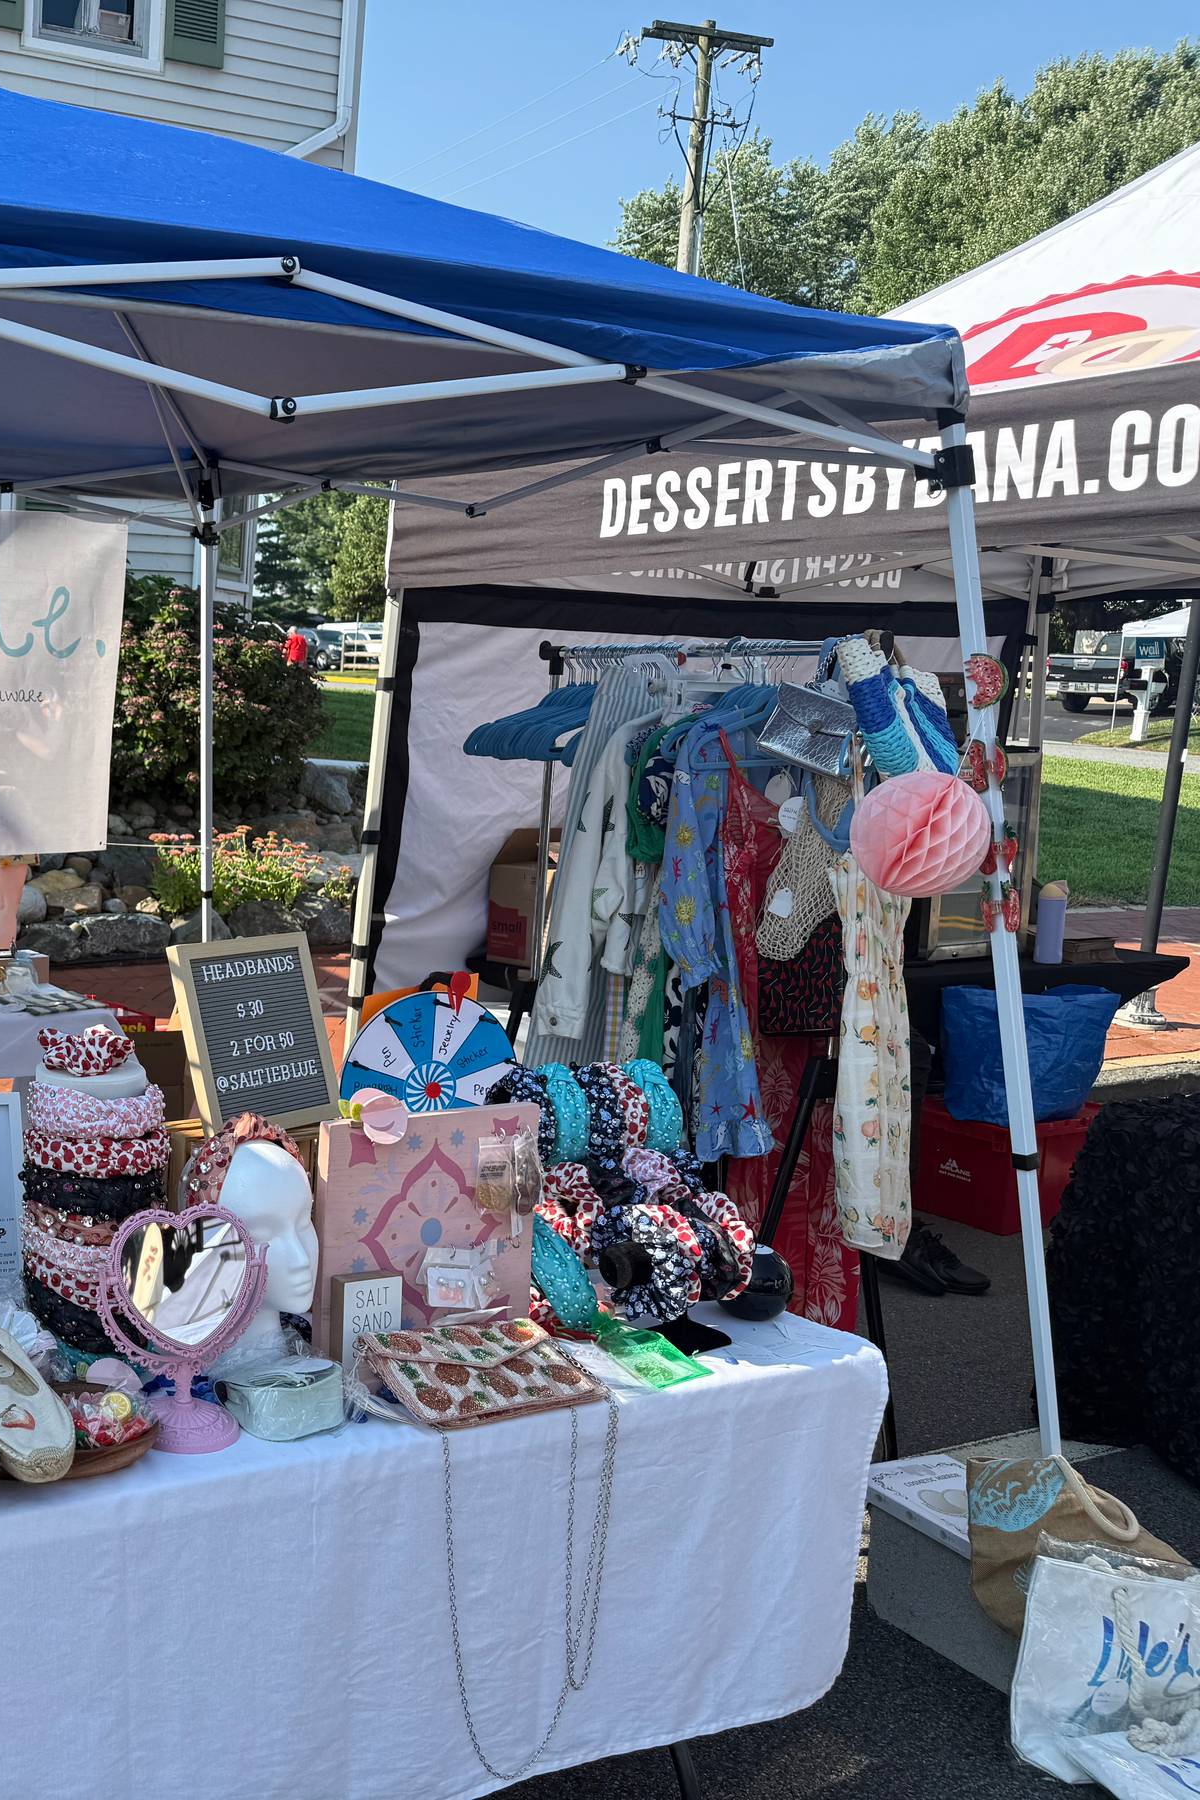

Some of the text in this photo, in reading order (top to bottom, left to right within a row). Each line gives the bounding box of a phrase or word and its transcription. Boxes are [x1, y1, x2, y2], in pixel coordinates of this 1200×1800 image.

[201, 955, 294, 983] HEADBANDS
[248, 999, 264, 1018] 30
[408, 1007, 425, 1049] Sticker
[439, 1014, 461, 1056] Jewelry
[230, 1031, 294, 1057] 2 FOR 50
[382, 1046, 398, 1068] Pen
[456, 1046, 490, 1068] Sticker
[216, 1059, 318, 1093] @SALTIEBLUE
[356, 1286, 389, 1309] SALT
[352, 1311, 392, 1334] SAND
